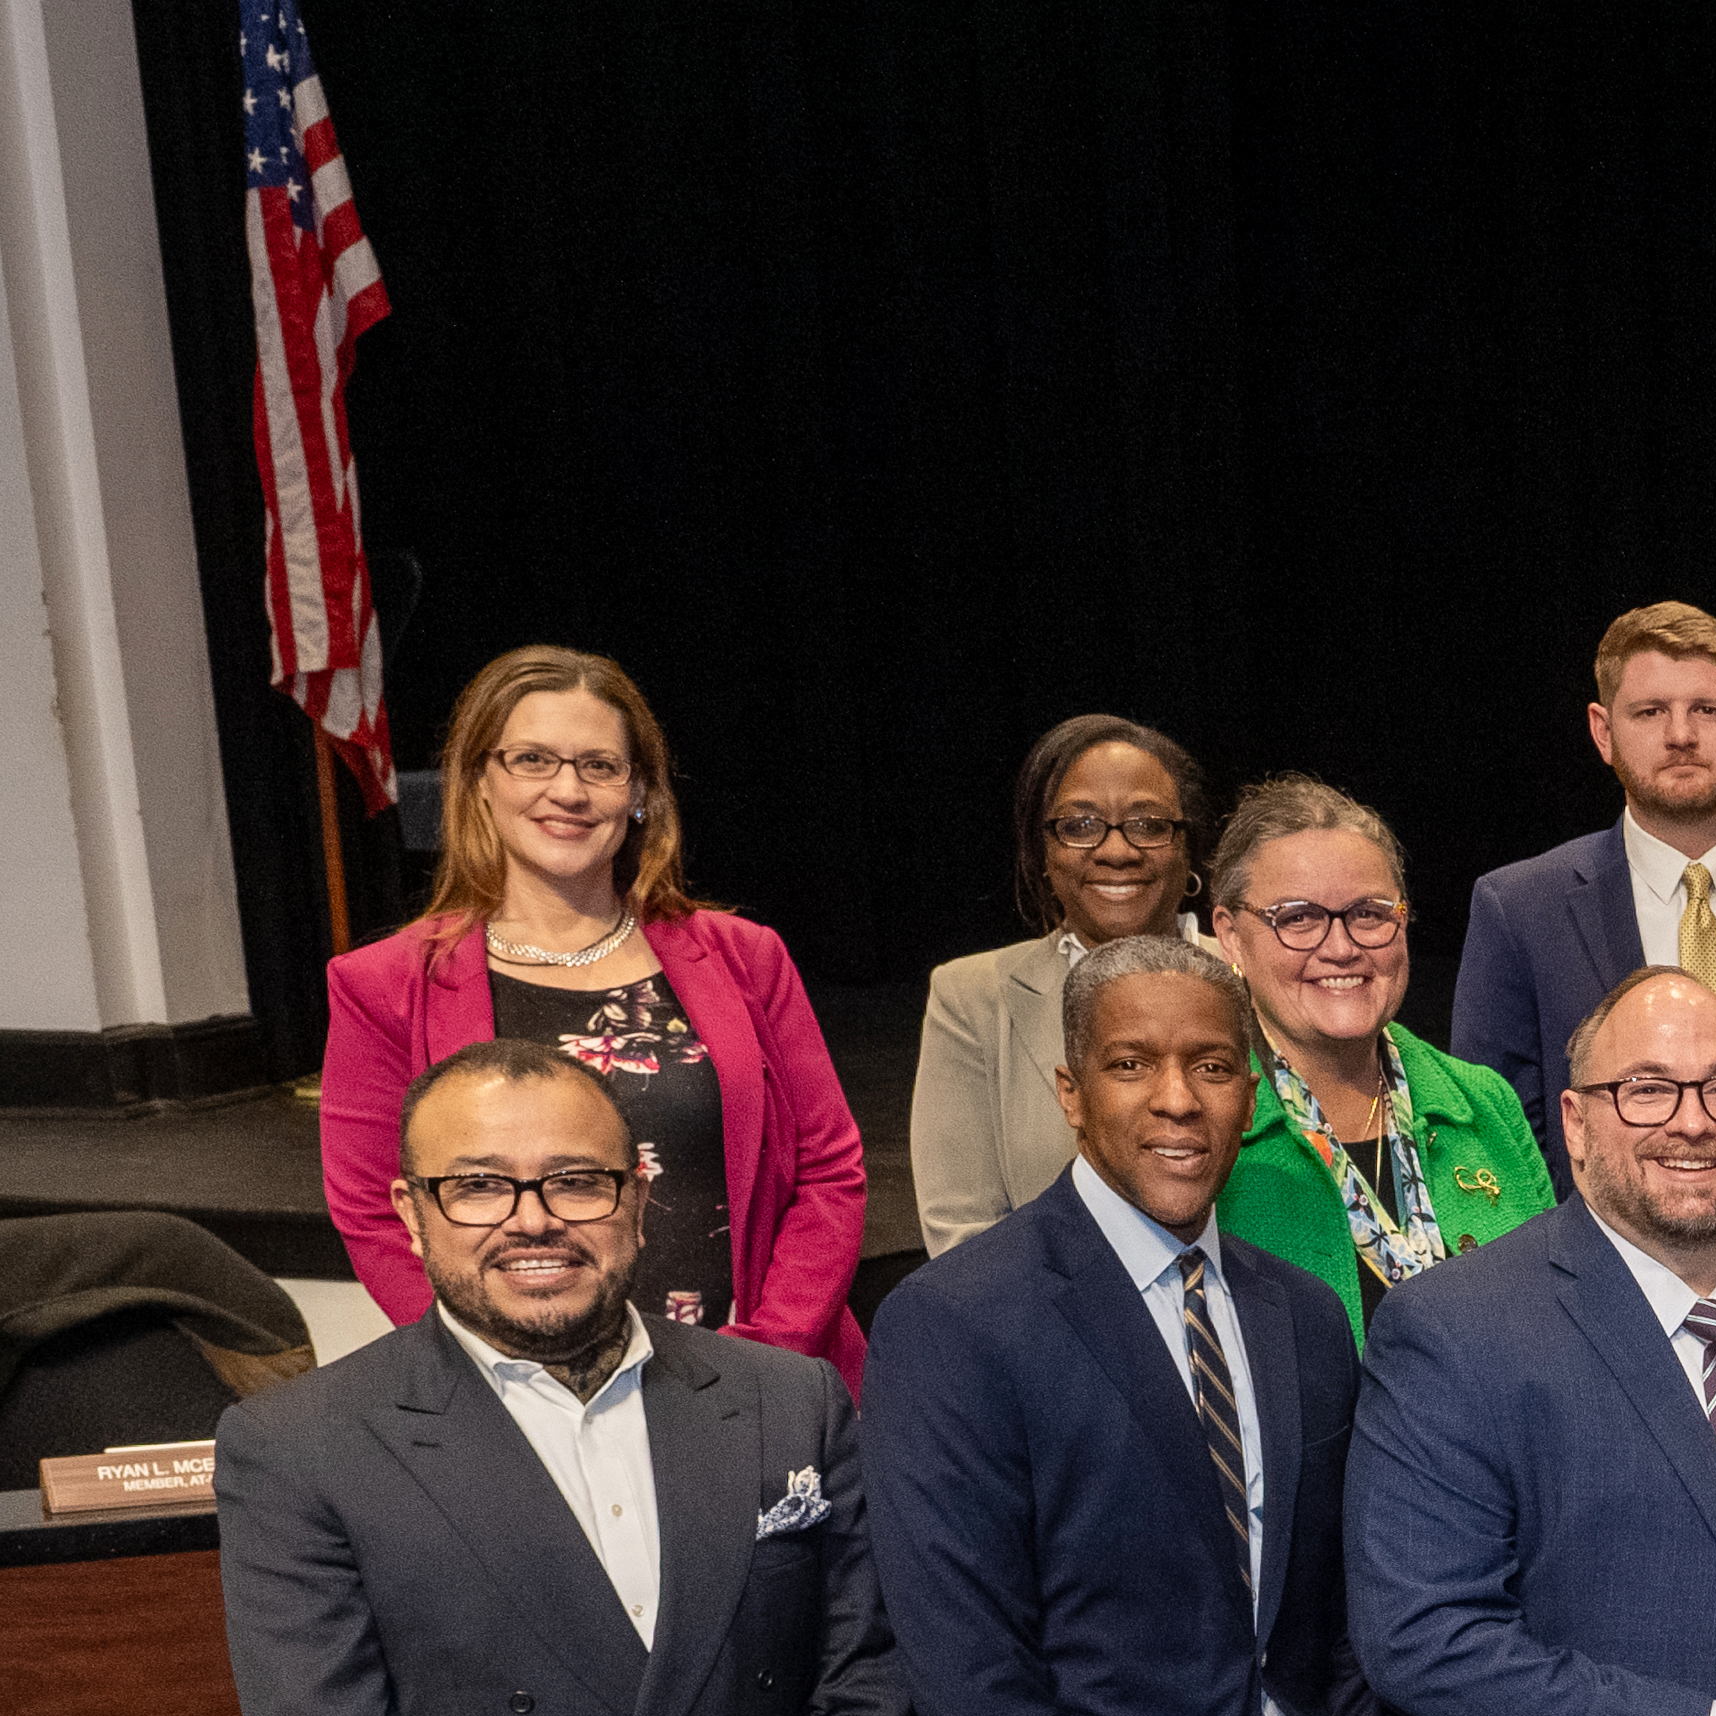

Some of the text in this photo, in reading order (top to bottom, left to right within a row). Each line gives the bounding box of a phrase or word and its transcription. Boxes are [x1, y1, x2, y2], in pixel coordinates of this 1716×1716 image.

[97, 1463, 150, 1481] RYAN
[153, 1462, 170, 1476] L.
[123, 1472, 214, 1492] MEMBER, AT-
